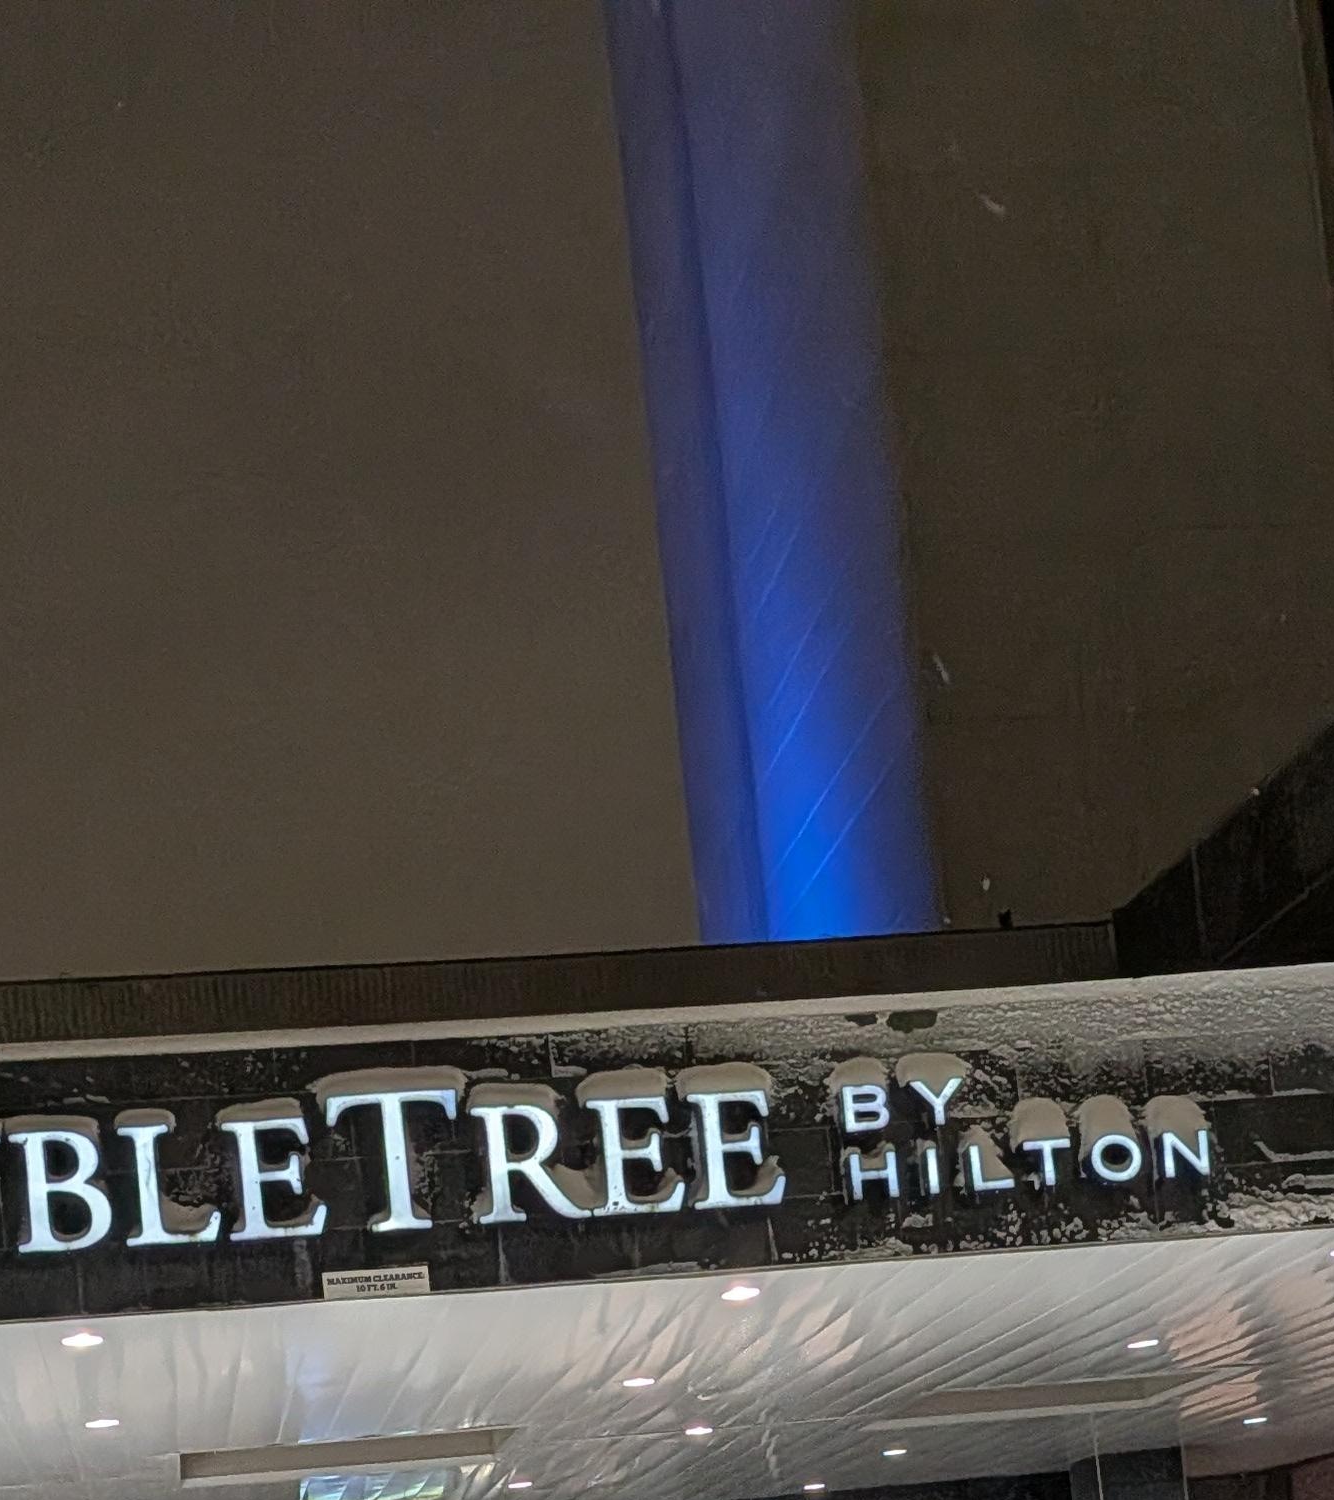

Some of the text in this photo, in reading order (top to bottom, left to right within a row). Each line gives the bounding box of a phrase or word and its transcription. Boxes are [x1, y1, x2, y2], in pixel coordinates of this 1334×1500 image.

[842, 1077, 963, 1132] BY
[850, 1130, 1210, 1201] HILTON
[326, 1275, 371, 1285] MAXIMUM
[356, 1284, 366, 1292] 10
